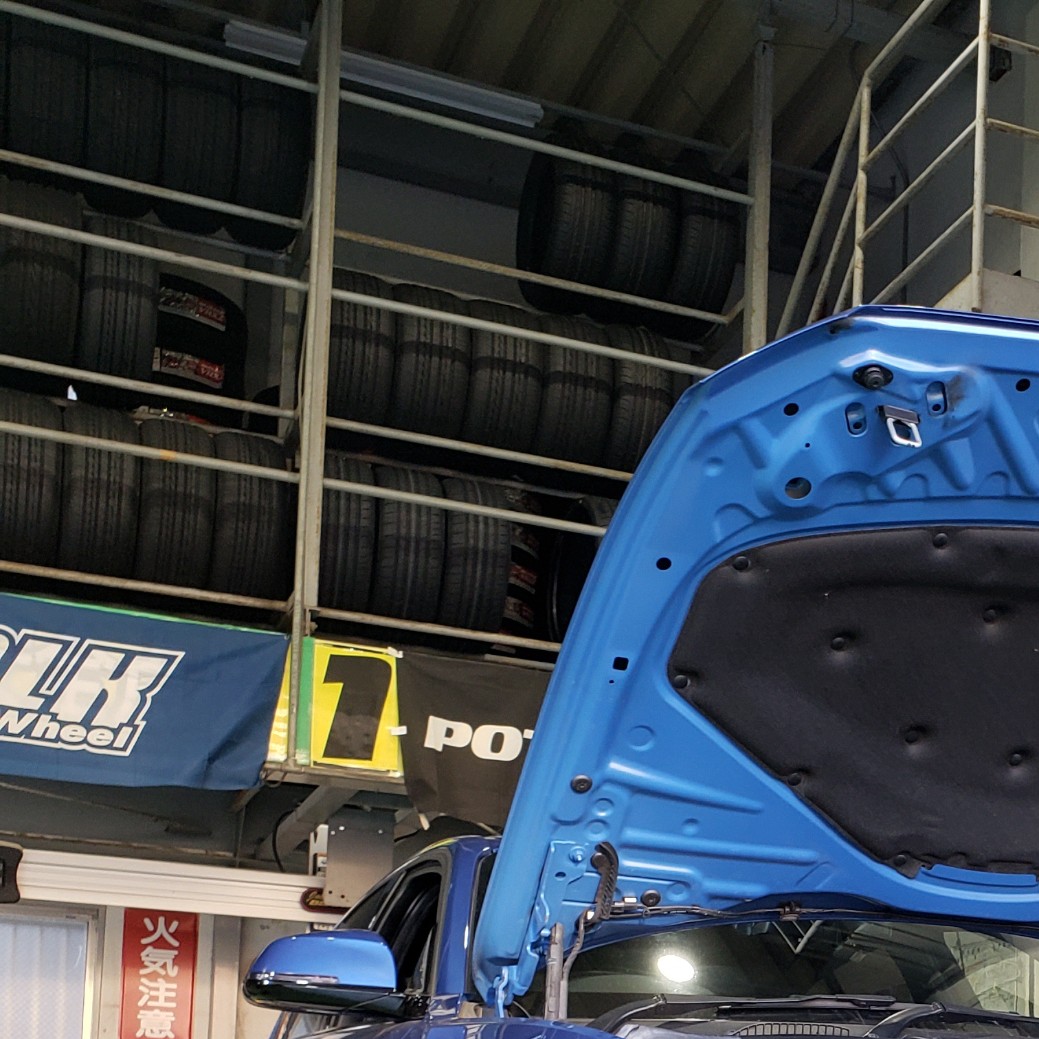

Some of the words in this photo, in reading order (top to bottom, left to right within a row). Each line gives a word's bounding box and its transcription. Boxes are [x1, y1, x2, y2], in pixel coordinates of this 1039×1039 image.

[0, 630, 170, 728] LK
[424, 715, 535, 761] PO
[136, 915, 180, 1039] 火気注意
